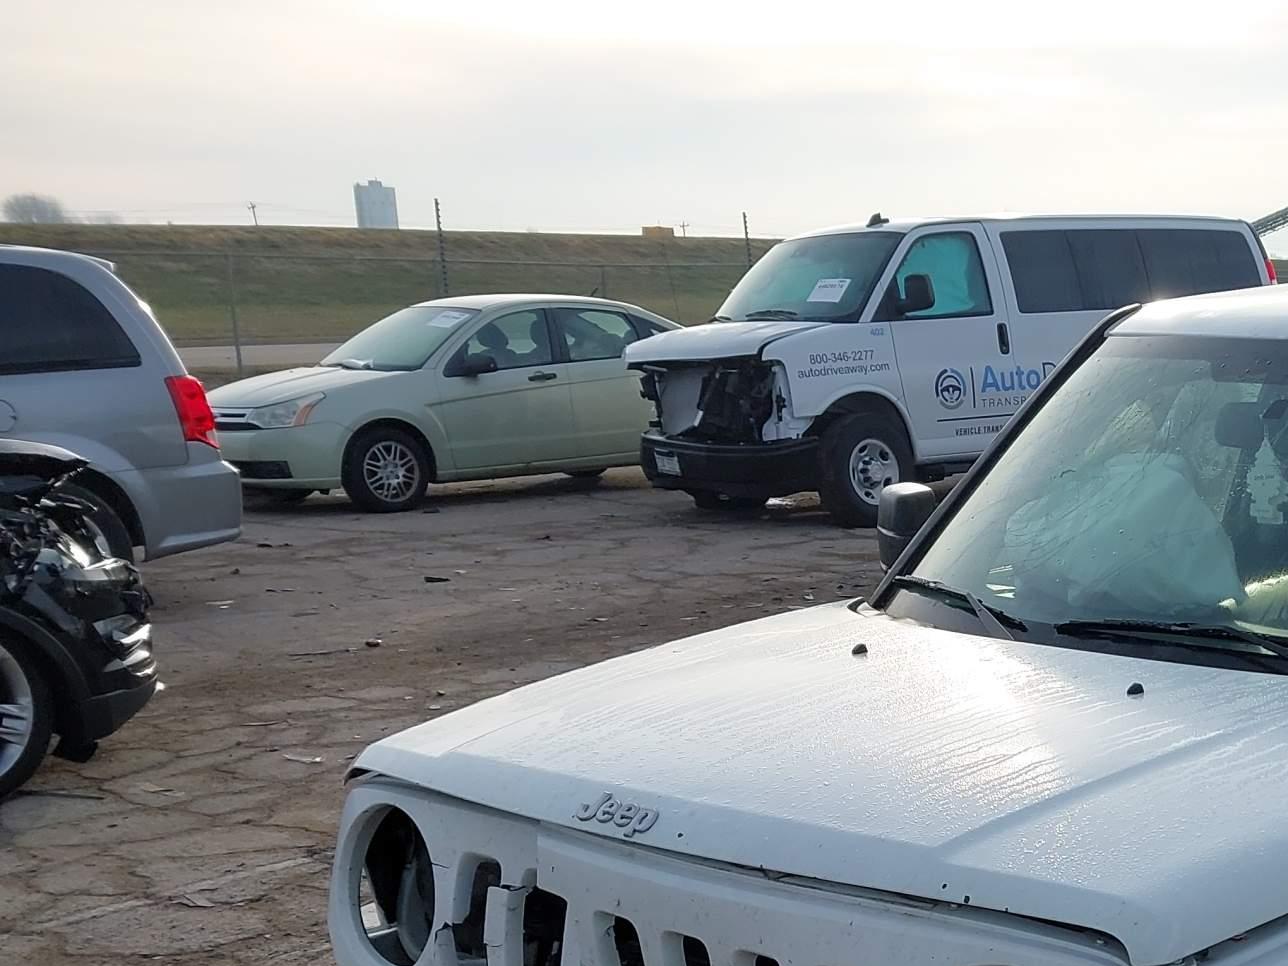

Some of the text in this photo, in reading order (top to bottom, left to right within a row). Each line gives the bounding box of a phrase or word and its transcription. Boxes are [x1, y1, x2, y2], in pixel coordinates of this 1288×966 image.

[809, 349, 875, 365] 800-346-2277
[797, 362, 890, 380] autodriveaway.com
[576, 791, 660, 838] Jeep
